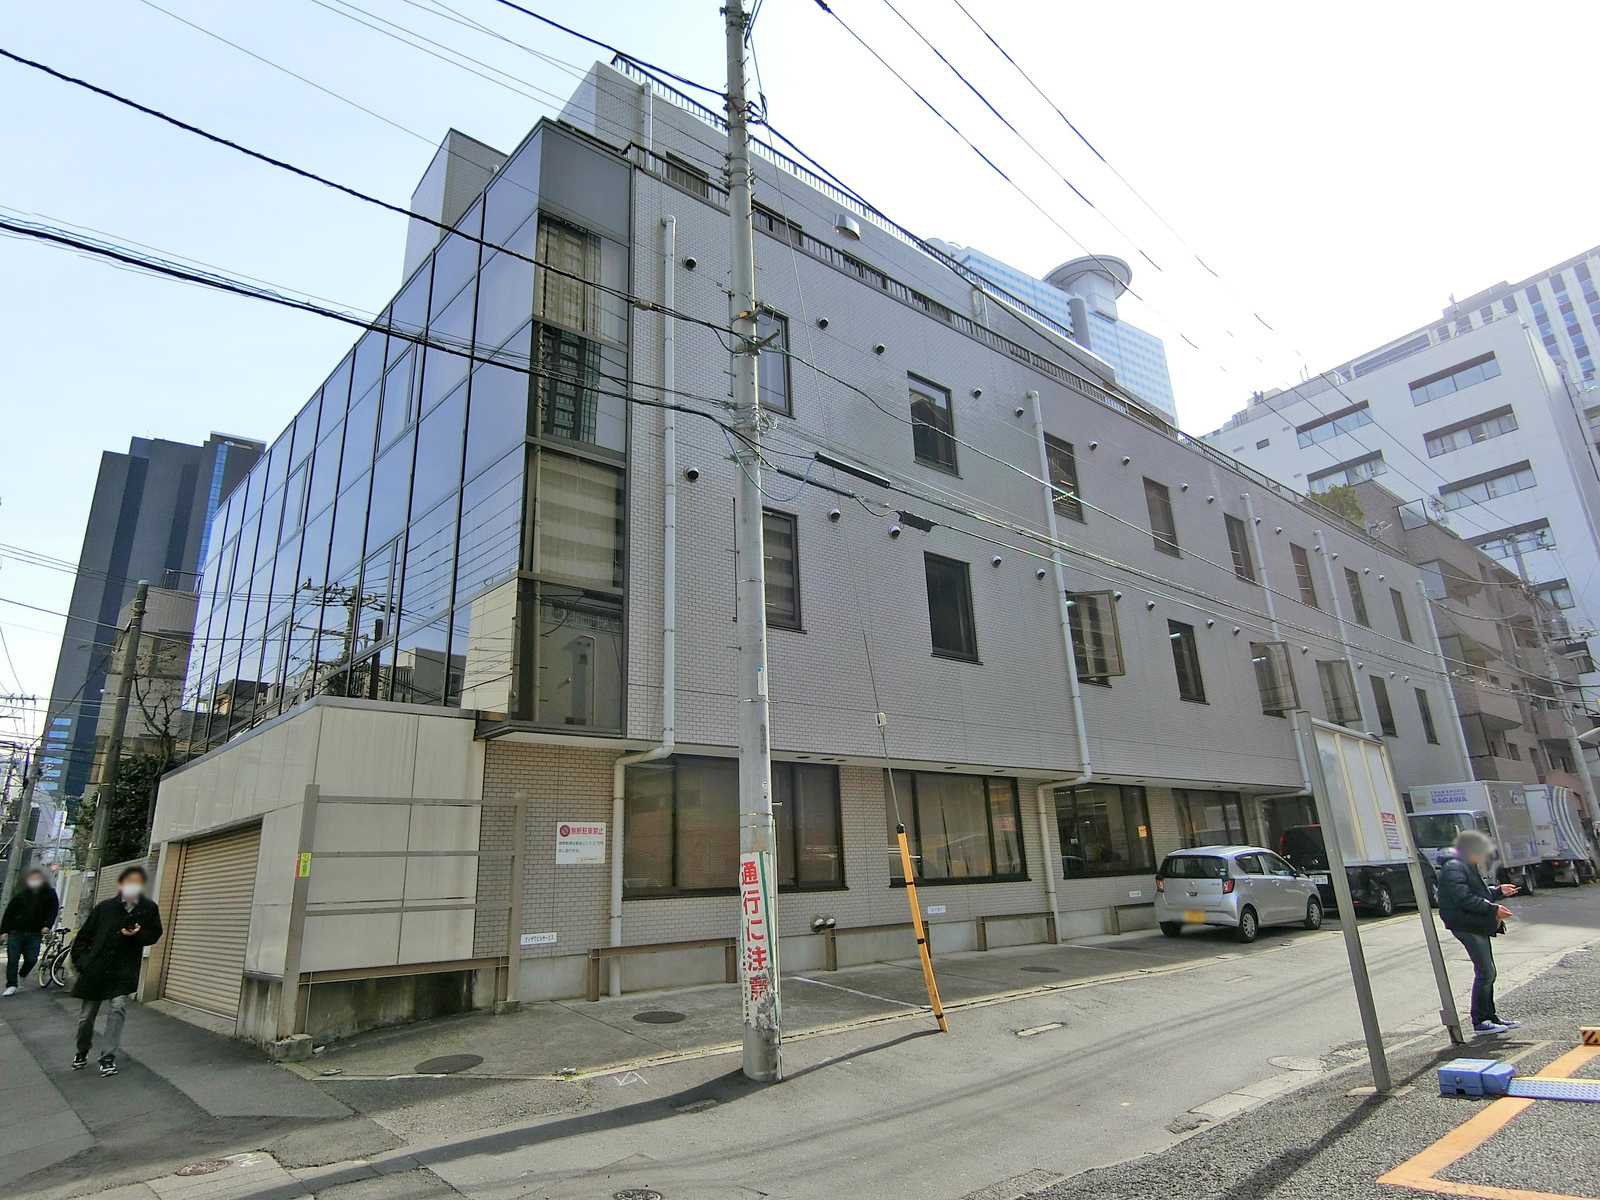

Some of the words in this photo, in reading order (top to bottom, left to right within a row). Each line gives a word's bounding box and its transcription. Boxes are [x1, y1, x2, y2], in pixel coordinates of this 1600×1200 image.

[1432, 796, 1468, 804] SAGAWA
[571, 827, 604, 835] 無断駐車禁止
